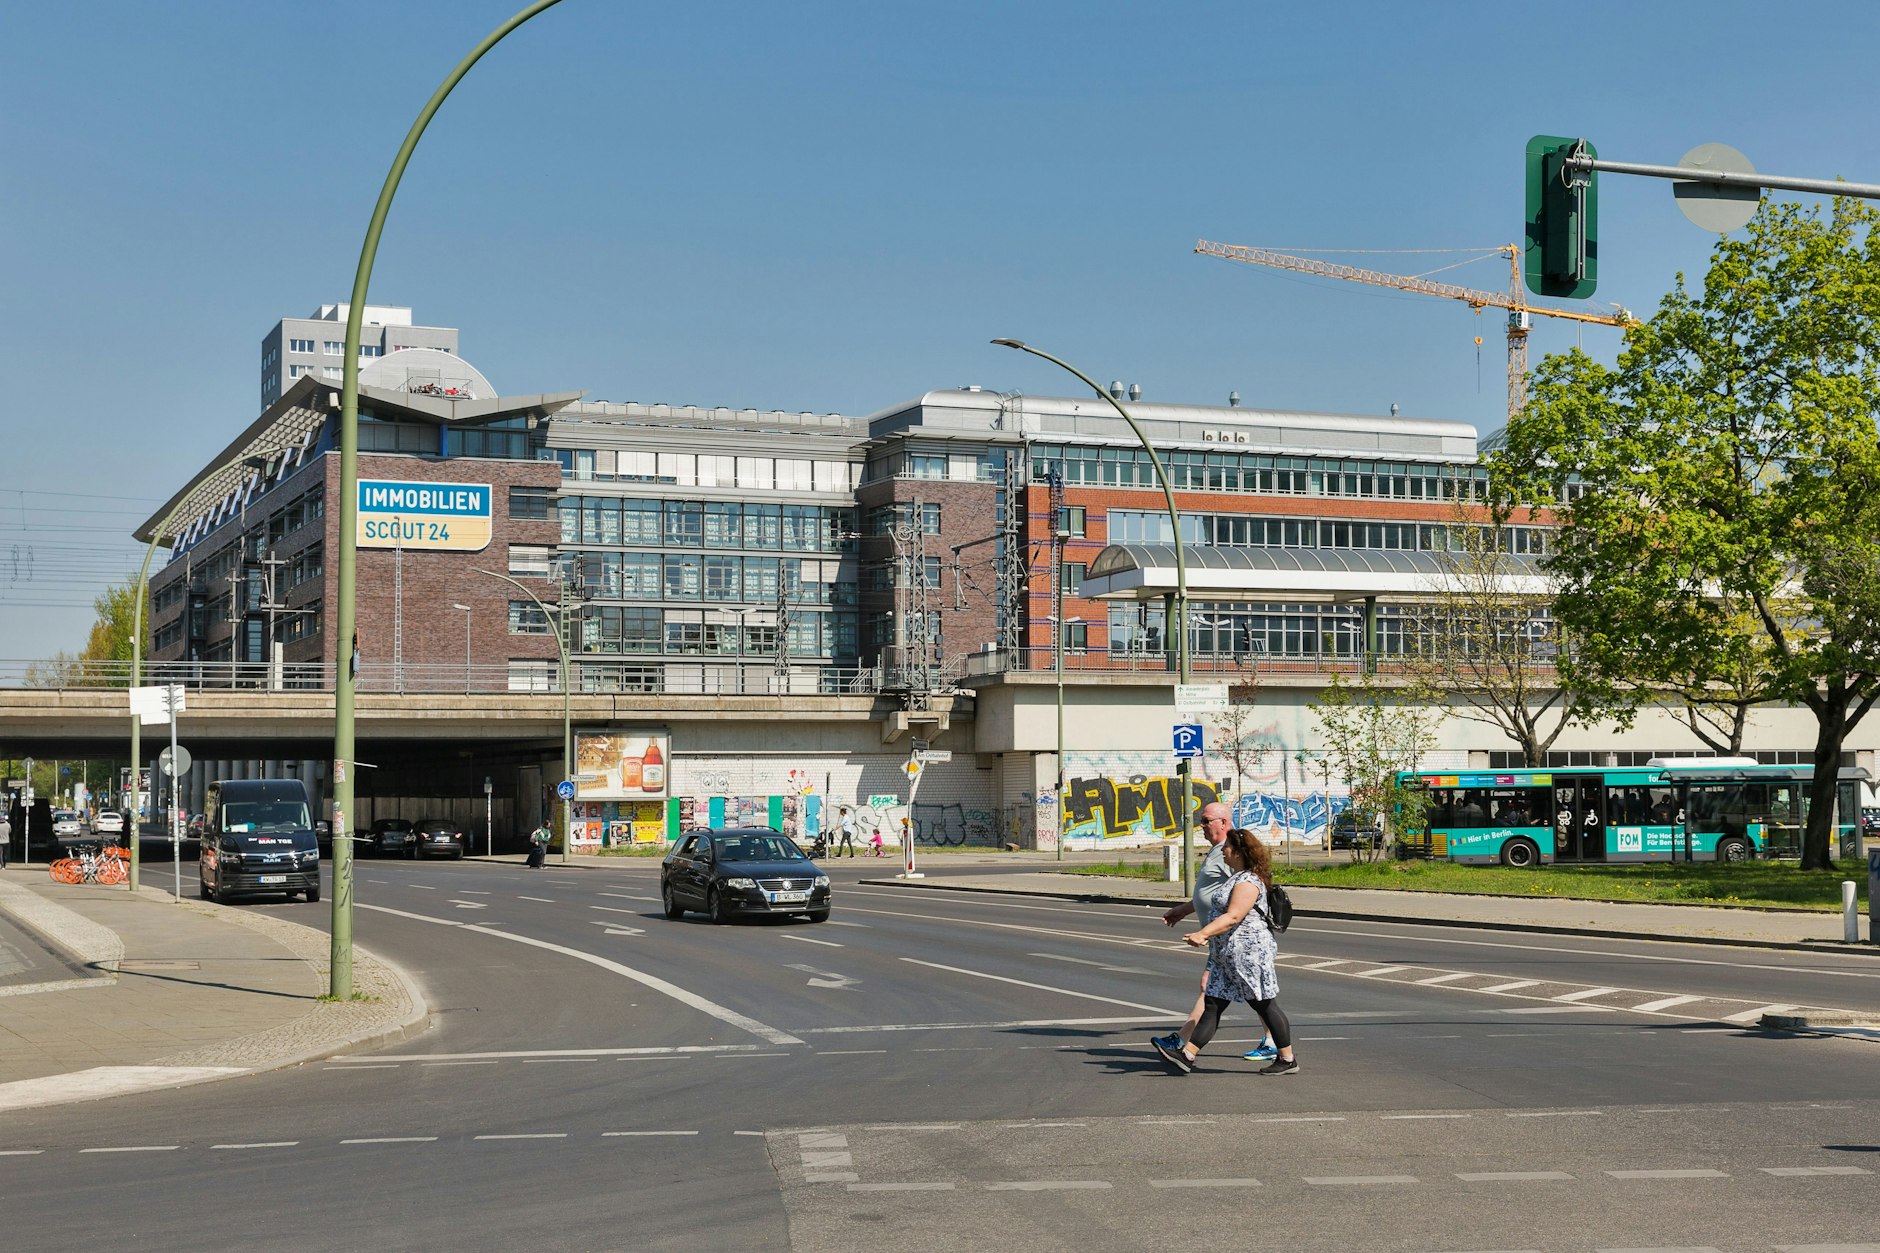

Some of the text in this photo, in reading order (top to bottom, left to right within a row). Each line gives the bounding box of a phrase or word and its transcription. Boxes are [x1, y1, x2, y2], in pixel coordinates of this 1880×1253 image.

[365, 487, 481, 511] IMMOBILIEN
[1179, 732, 1192, 749] P
[1491, 829, 1514, 839] Berlin.
[1620, 833, 1639, 846] FOM
[1647, 838, 1658, 846] Für
